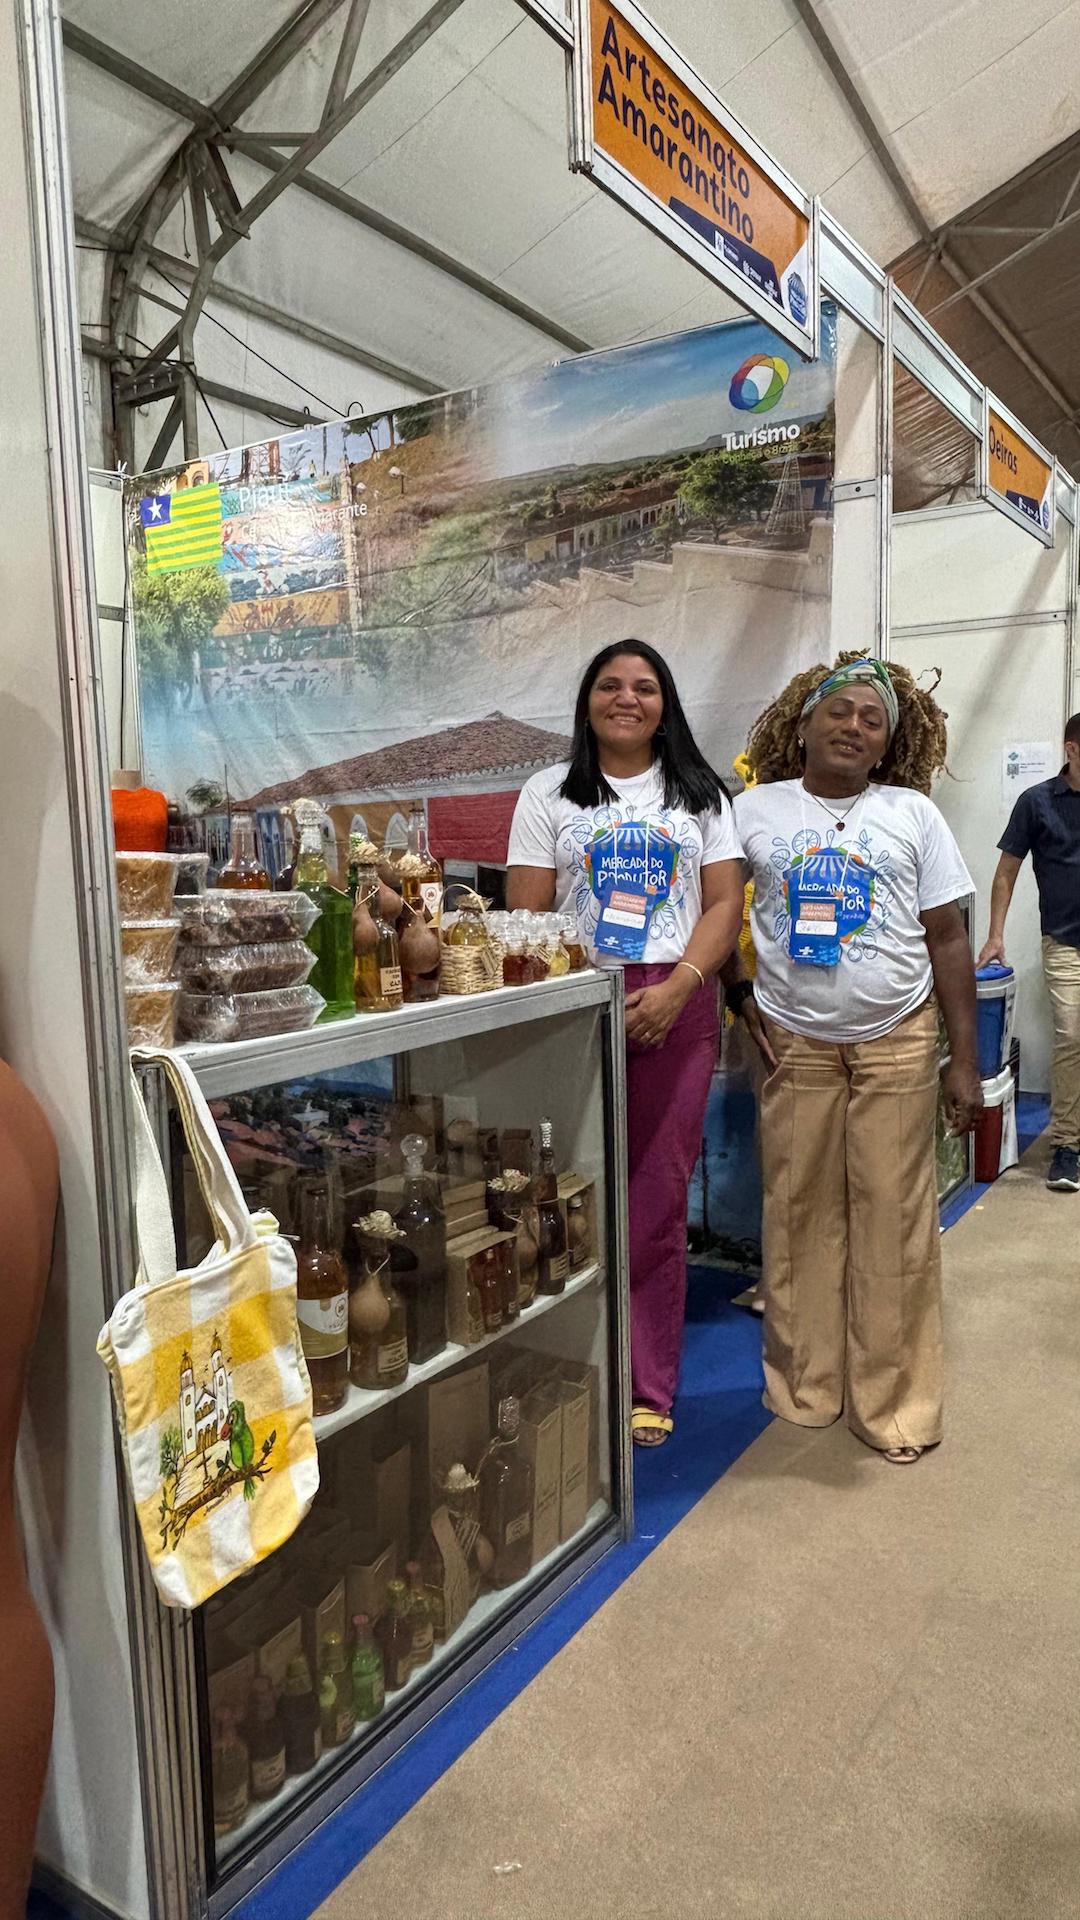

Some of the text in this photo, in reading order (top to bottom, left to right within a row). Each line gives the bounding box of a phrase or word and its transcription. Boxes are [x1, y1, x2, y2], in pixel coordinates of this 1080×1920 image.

[601, 16, 751, 198] Artesanato
[598, 64, 754, 244] Amarantino
[722, 423, 801, 451] Turismo
[988, 425, 1018, 474] Oeiras
[601, 856, 664, 869] MERCADO DO
[847, 884, 860, 895] DO
